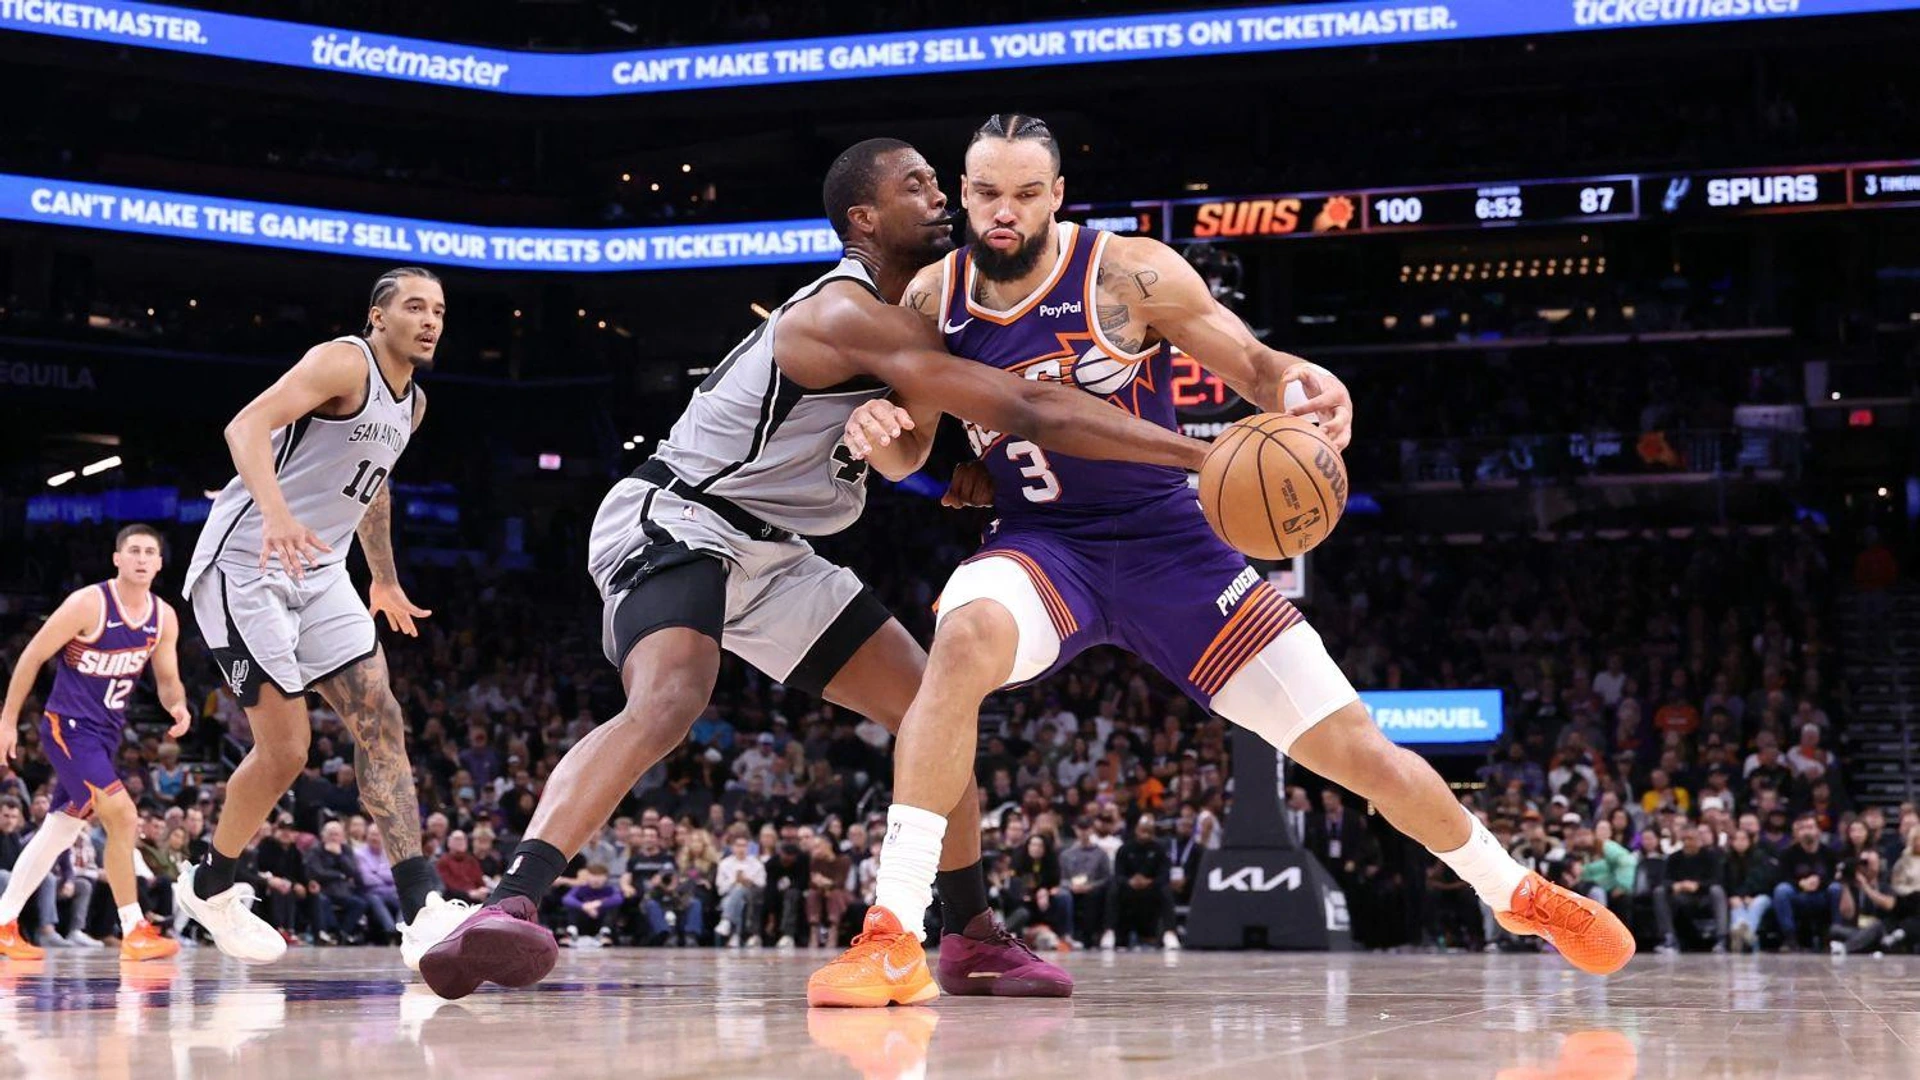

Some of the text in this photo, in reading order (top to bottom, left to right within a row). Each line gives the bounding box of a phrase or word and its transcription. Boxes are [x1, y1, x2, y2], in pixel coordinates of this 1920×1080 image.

[0, 0, 207, 44] TICKETMASTER.
[311, 34, 508, 86] ticketmaster
[613, 6, 1457, 84] CAN'T MAKE THE GAME? SELL YOUR TICKETS ON TICKETMASTER.
[1580, 187, 1614, 213] 87
[1707, 174, 1818, 206] SPURS
[1194, 199, 1301, 237] SUNS
[1375, 197, 1422, 224] 100
[1475, 196, 1522, 218] 6:52
[31, 189, 116, 219] CAN'T
[121, 198, 197, 228] MAKE
[203, 207, 254, 234] THE
[260, 214, 348, 243] GAME?
[353, 223, 412, 251] SELL
[416, 230, 487, 259] YOUR
[490, 236, 600, 262] TICKETS
[605, 237, 647, 262] ON
[1039, 301, 1082, 319] PayPal
[348, 423, 380, 442] SAN
[342, 459, 388, 505] 10
[1006, 440, 1062, 503] 3
[77, 650, 148, 676] SUNS
[103, 678, 133, 709] 12
[1376, 707, 1488, 729] FANDUEL
[1208, 866, 1301, 891] KIA
